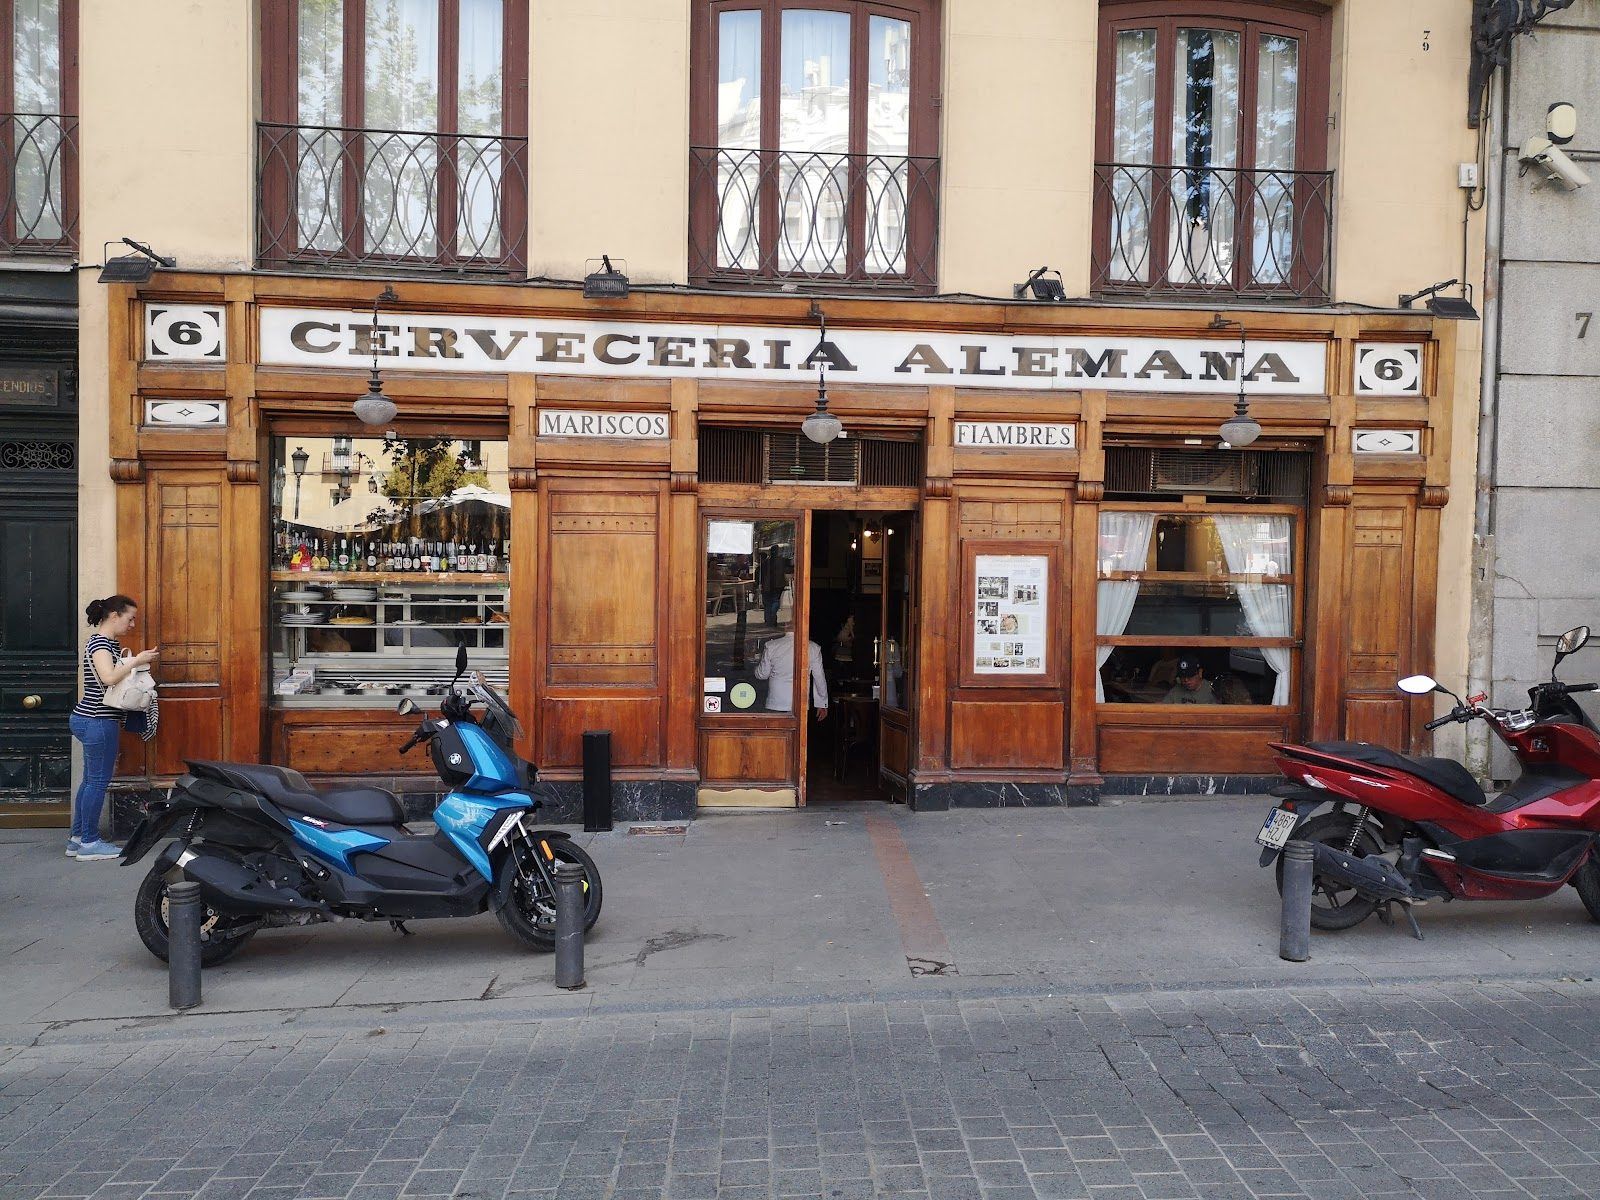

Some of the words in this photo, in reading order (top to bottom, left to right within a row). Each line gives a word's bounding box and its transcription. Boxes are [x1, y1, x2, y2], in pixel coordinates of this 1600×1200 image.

[1424, 30, 1431, 39] 7
[1423, 42, 1430, 51] 9
[167, 320, 203, 345] 6
[1575, 312, 1593, 339] 7
[290, 321, 858, 371] CERVECERIA
[894, 343, 1300, 383] ALEMANA
[1373, 358, 1404, 381] 6
[544, 414, 665, 436] MARISCOS
[957, 424, 1071, 446] FIAMBRES
[1273, 813, 1296, 829] 4867
[1265, 826, 1284, 841] HZJ
